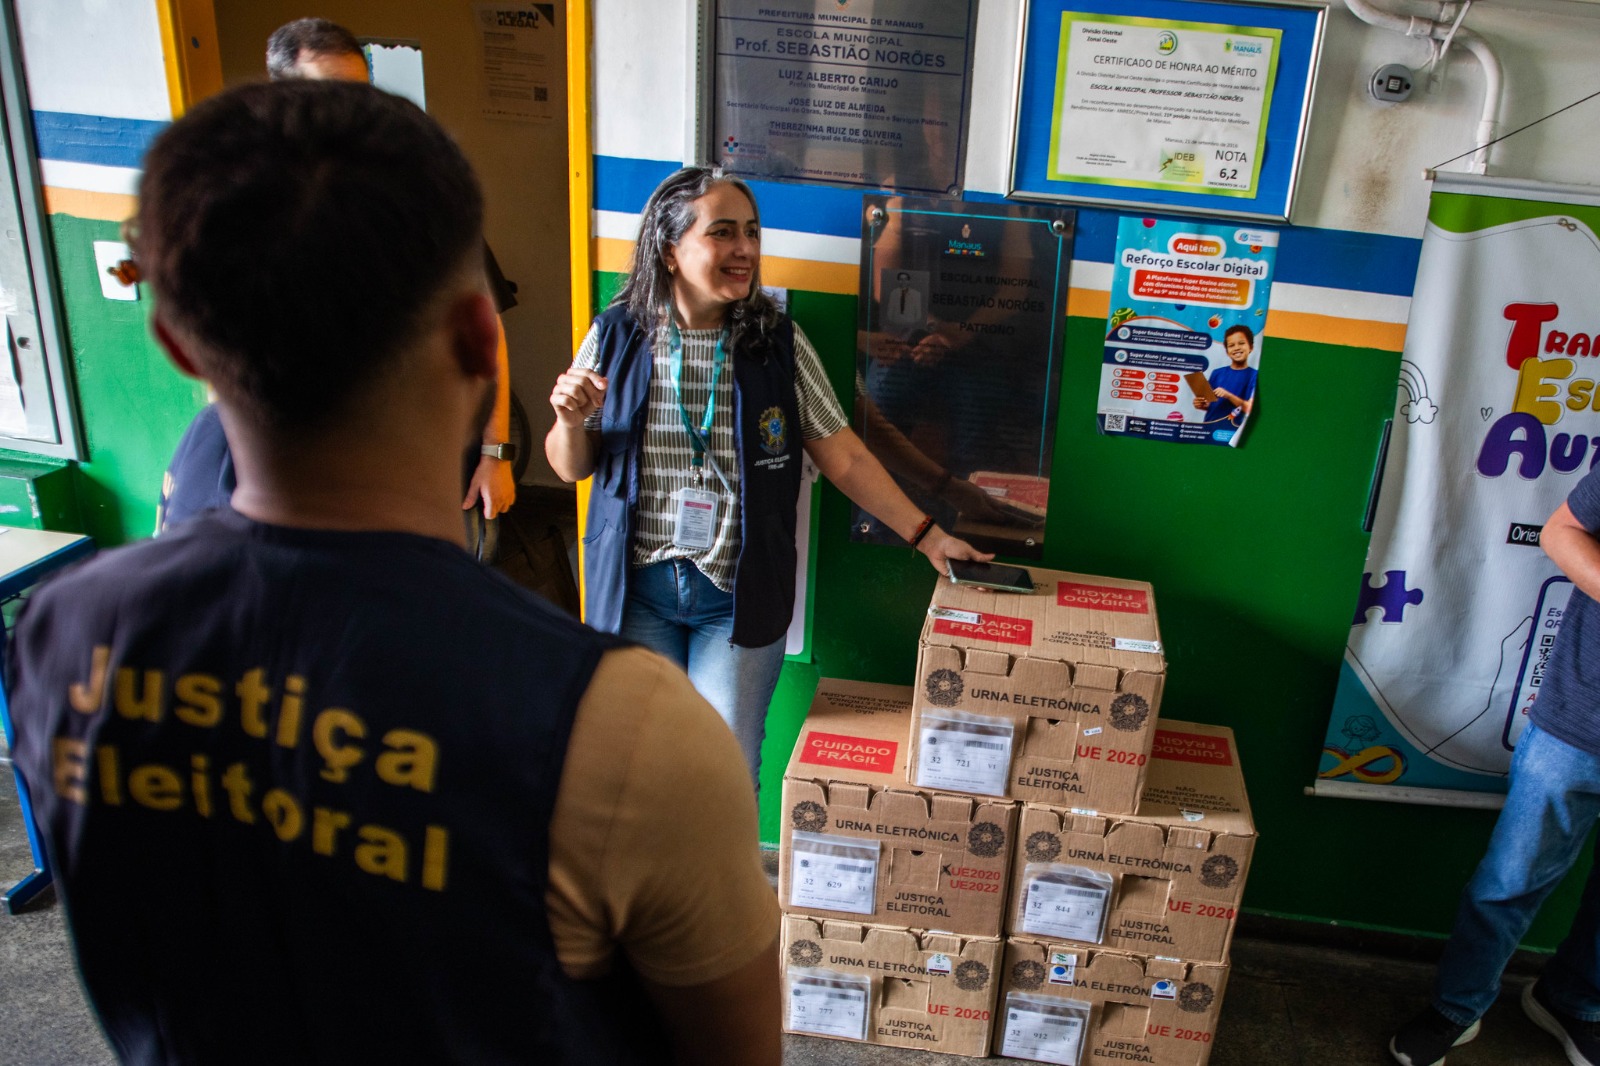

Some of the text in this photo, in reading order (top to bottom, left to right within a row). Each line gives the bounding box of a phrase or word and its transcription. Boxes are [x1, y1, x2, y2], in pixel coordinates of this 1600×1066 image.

[758, 9, 924, 30] PREFEITURA MUNICIPAL DE MANAUS
[777, 28, 904, 47] ESCOLA MUNICIPAL
[1082, 28, 1123, 37] Divisão Distrital
[1086, 36, 1101, 44] Zonal
[735, 37, 770, 53] Prof.
[776, 41, 870, 61] SEBASTIÃO
[1233, 45, 1262, 54] MANAUS
[1093, 55, 1257, 78] CERTIFICADO DE HONRA AO MÉRITO
[778, 69, 898, 89] LUIZ ALBERTO CARIJÓ
[789, 81, 816, 90] Prefeito
[817, 83, 849, 92] Municipal
[861, 87, 887, 95] Manaus
[1090, 83, 1113, 92] ESCOLA
[1114, 86, 1147, 94] MUNICIPAL
[1148, 88, 1182, 97] PROFESSOR
[759, 103, 790, 113] Municipal
[823, 109, 862, 119] Saneamento
[812, 99, 832, 109] LUIZ
[834, 101, 845, 110] DE
[848, 102, 886, 114] ALMEIDA
[769, 121, 902, 140] THEREZINHA RUIZ DE OLIVEIRA
[802, 133, 833, 143] Municipal
[1174, 152, 1195, 163] IDEB
[1215, 150, 1247, 163] NOTA
[1219, 168, 1238, 181] 6,2
[948, 240, 982, 250] Manaus
[1177, 241, 1217, 253] Aqui tem
[1126, 253, 1263, 278] Reforço Escolar Digital
[940, 272, 1040, 289] ESCOLA MUNICIPAL
[1151, 275, 1182, 283] Plataforma
[1182, 278, 1199, 286] Super
[1199, 279, 1217, 287] Ensino
[1155, 282, 1184, 290] dinamismo
[1208, 287, 1239, 295] estudantes
[932, 293, 995, 309] SEBASTIÃO
[959, 322, 1015, 335] PATRONO
[1063, 595, 1142, 609] CUIDADO
[1071, 588, 1134, 601] FRÁGIL
[950, 622, 1017, 640] FRÁGIL
[1051, 634, 1079, 642] URNA
[1042, 637, 1070, 645] FORA
[838, 702, 902, 714] TRANSPORTAR
[971, 688, 1101, 715] URNA ELETRÔNICA
[69, 645, 440, 794] Justiça
[811, 739, 890, 756] CUIDADO
[1158, 736, 1216, 750] FRÁGIL
[816, 750, 880, 766] FRÁGIL
[1077, 744, 1148, 767] UE 2020
[1152, 744, 1225, 760] CUIDADO
[930, 756, 970, 769] 32 721
[1028, 766, 1079, 783] JUSTIÇA
[1018, 777, 1085, 794] ELEITORAL
[1143, 792, 1169, 800] URNA
[1148, 787, 1216, 800] TRANSPORTAR
[51, 734, 449, 894] Eleitoral
[1180, 801, 1240, 813] EMBALAGEM
[835, 819, 960, 844] URNA ELETRÔNICA
[1068, 848, 1192, 875] URNA ELETRÔNICA
[951, 867, 1001, 882] UE2020
[803, 878, 843, 890] 32 629
[950, 880, 1000, 895] UE2022
[895, 892, 944, 907] JUSTIÇA
[1032, 901, 1042, 910] 32
[886, 902, 952, 919] ELEITORAL
[1169, 899, 1236, 921] UE 2020
[1121, 919, 1170, 935] JUSTIÇA
[1111, 928, 1175, 945] ELEITORAL
[830, 955, 864, 969] URNA
[1073, 978, 1089, 990] NA
[818, 1007, 833, 1016] 777
[928, 1002, 990, 1022] UE 2020
[885, 1019, 933, 1033] JUSTIÇA
[1148, 1023, 1211, 1044] UE 2020
[877, 1027, 939, 1043] ELEITORAL
[1010, 1029, 1048, 1041] 32 912
[1103, 1040, 1151, 1056] JUSTIÇA
[1094, 1048, 1155, 1066] ELEITORAL
